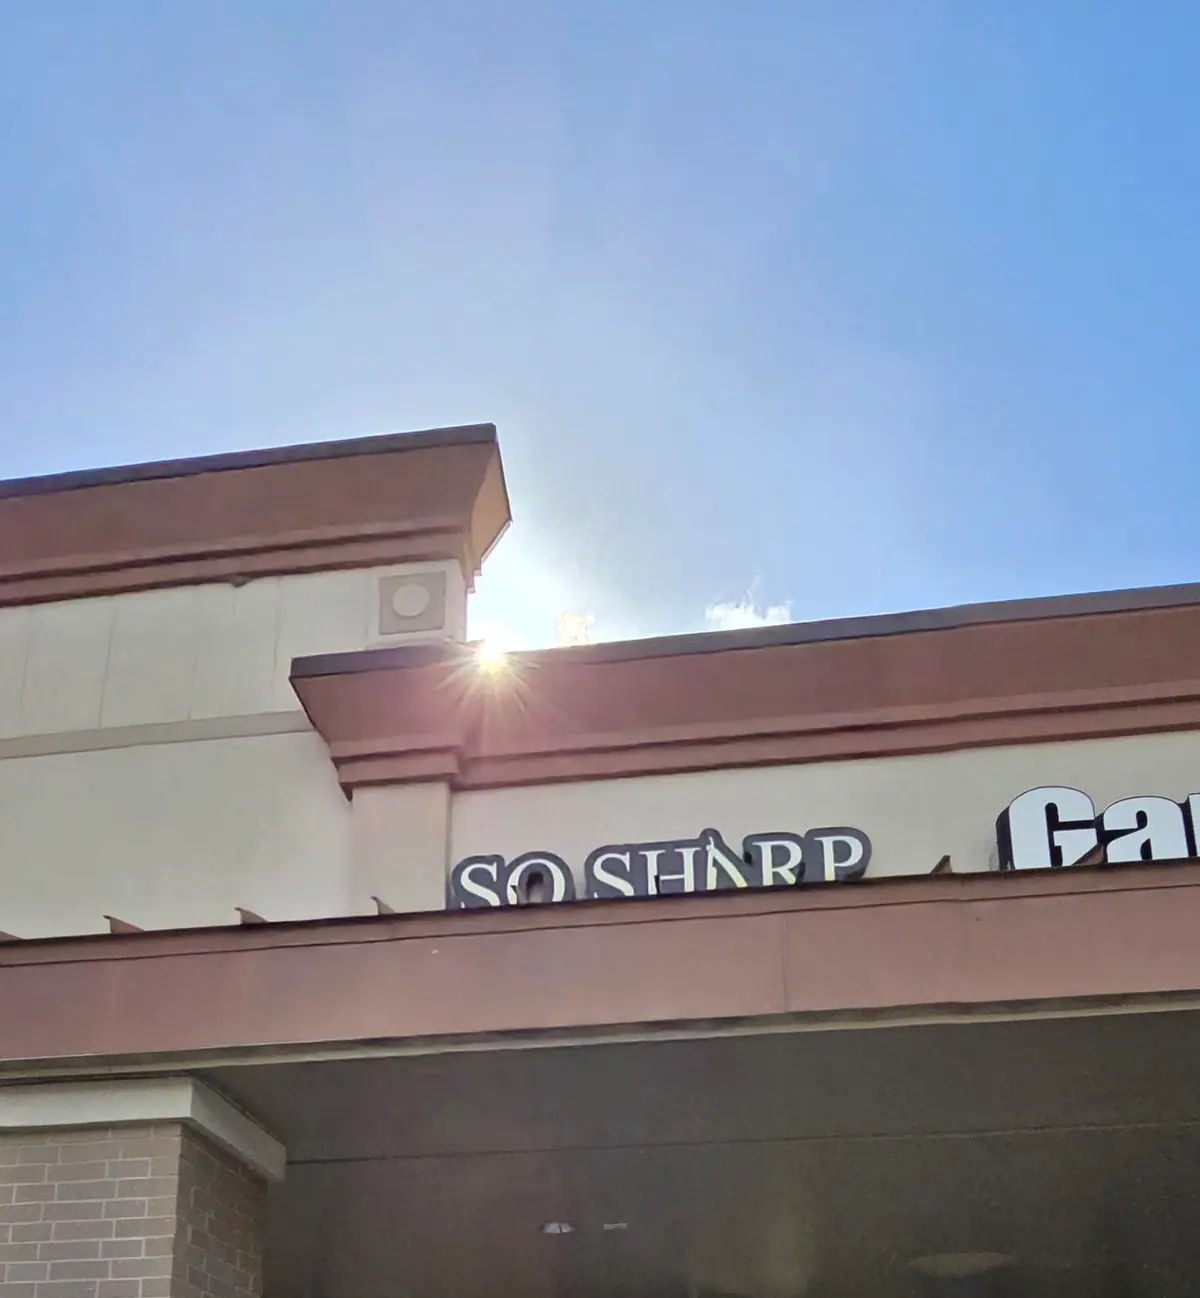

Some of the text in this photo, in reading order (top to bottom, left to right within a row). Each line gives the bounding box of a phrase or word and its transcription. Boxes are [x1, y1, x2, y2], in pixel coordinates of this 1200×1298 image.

[1000, 785, 1200, 870] Ga
[460, 833, 864, 908] SO SHARP
